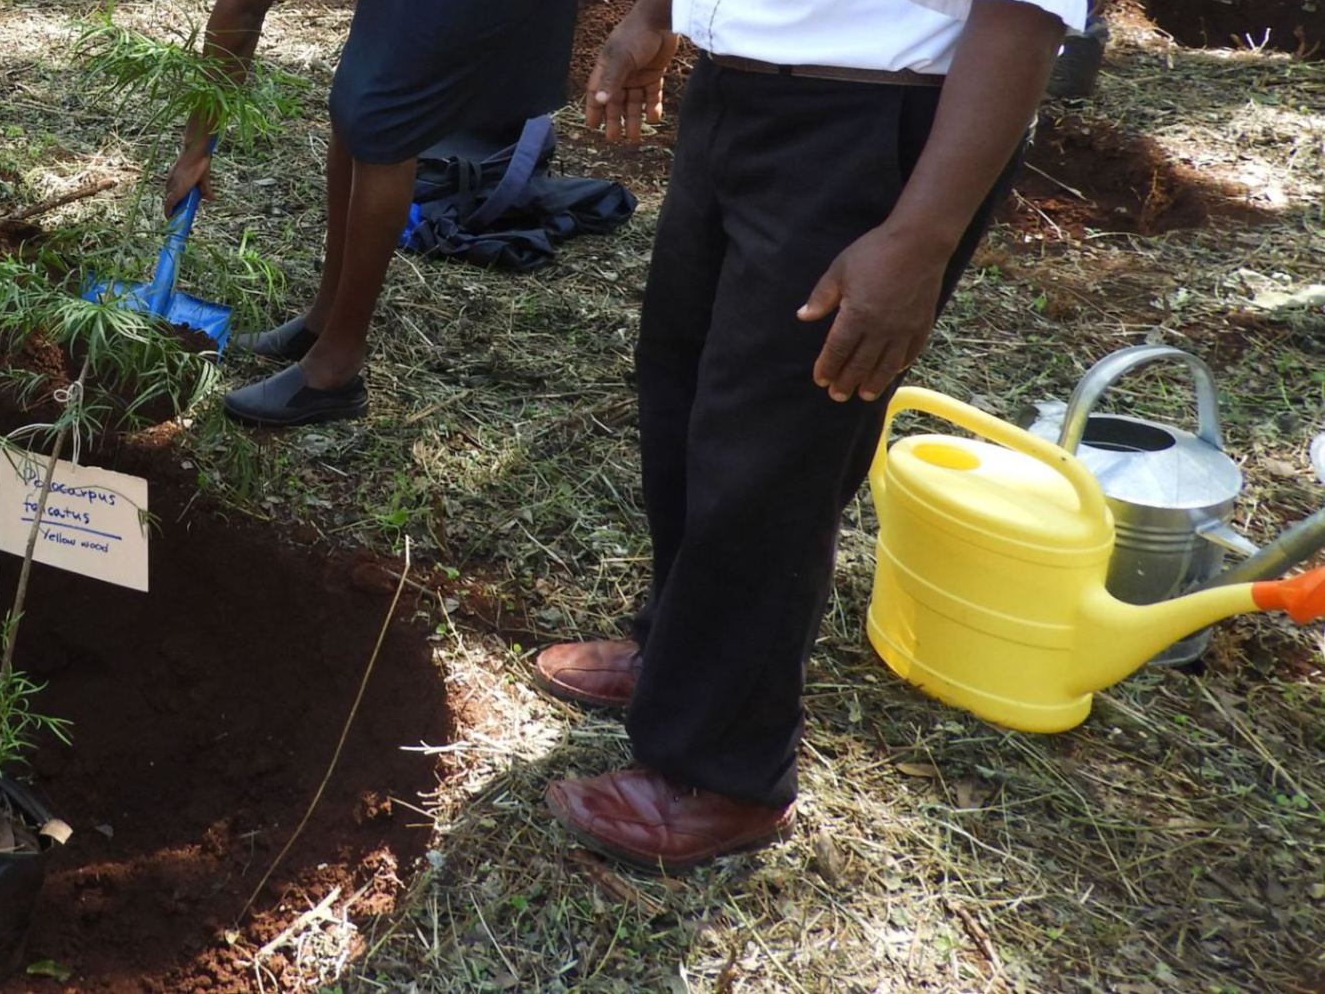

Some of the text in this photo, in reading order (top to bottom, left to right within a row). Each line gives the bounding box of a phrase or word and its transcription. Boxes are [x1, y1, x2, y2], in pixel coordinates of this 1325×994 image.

[23, 467, 117, 505] Poocarpus
[23, 494, 91, 524] facatus
[40, 527, 76, 546] Yellow
